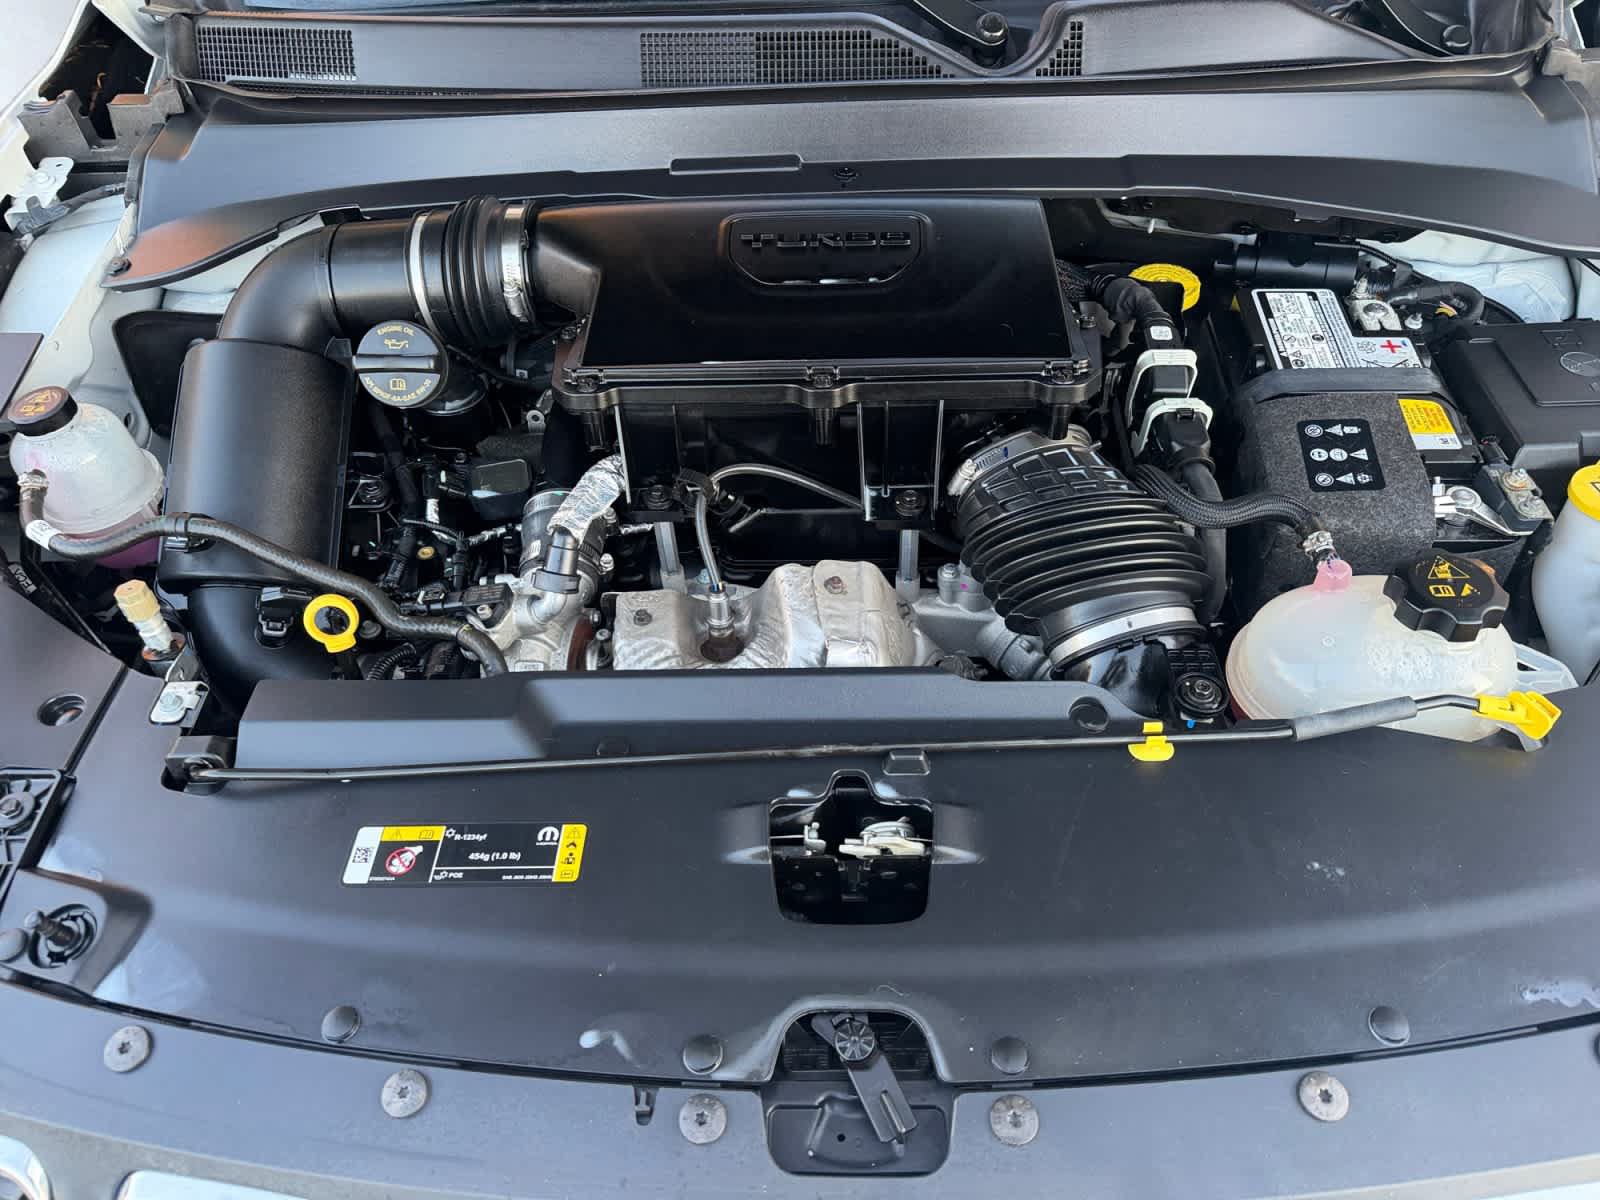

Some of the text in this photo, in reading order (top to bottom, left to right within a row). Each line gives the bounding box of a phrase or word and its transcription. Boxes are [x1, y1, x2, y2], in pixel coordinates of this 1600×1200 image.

[740, 231, 912, 248] TURBO
[377, 325, 402, 336] ENGINE
[454, 833, 488, 842] R-1234yf
[468, 851, 521, 862] 454g (1.0 lb)
